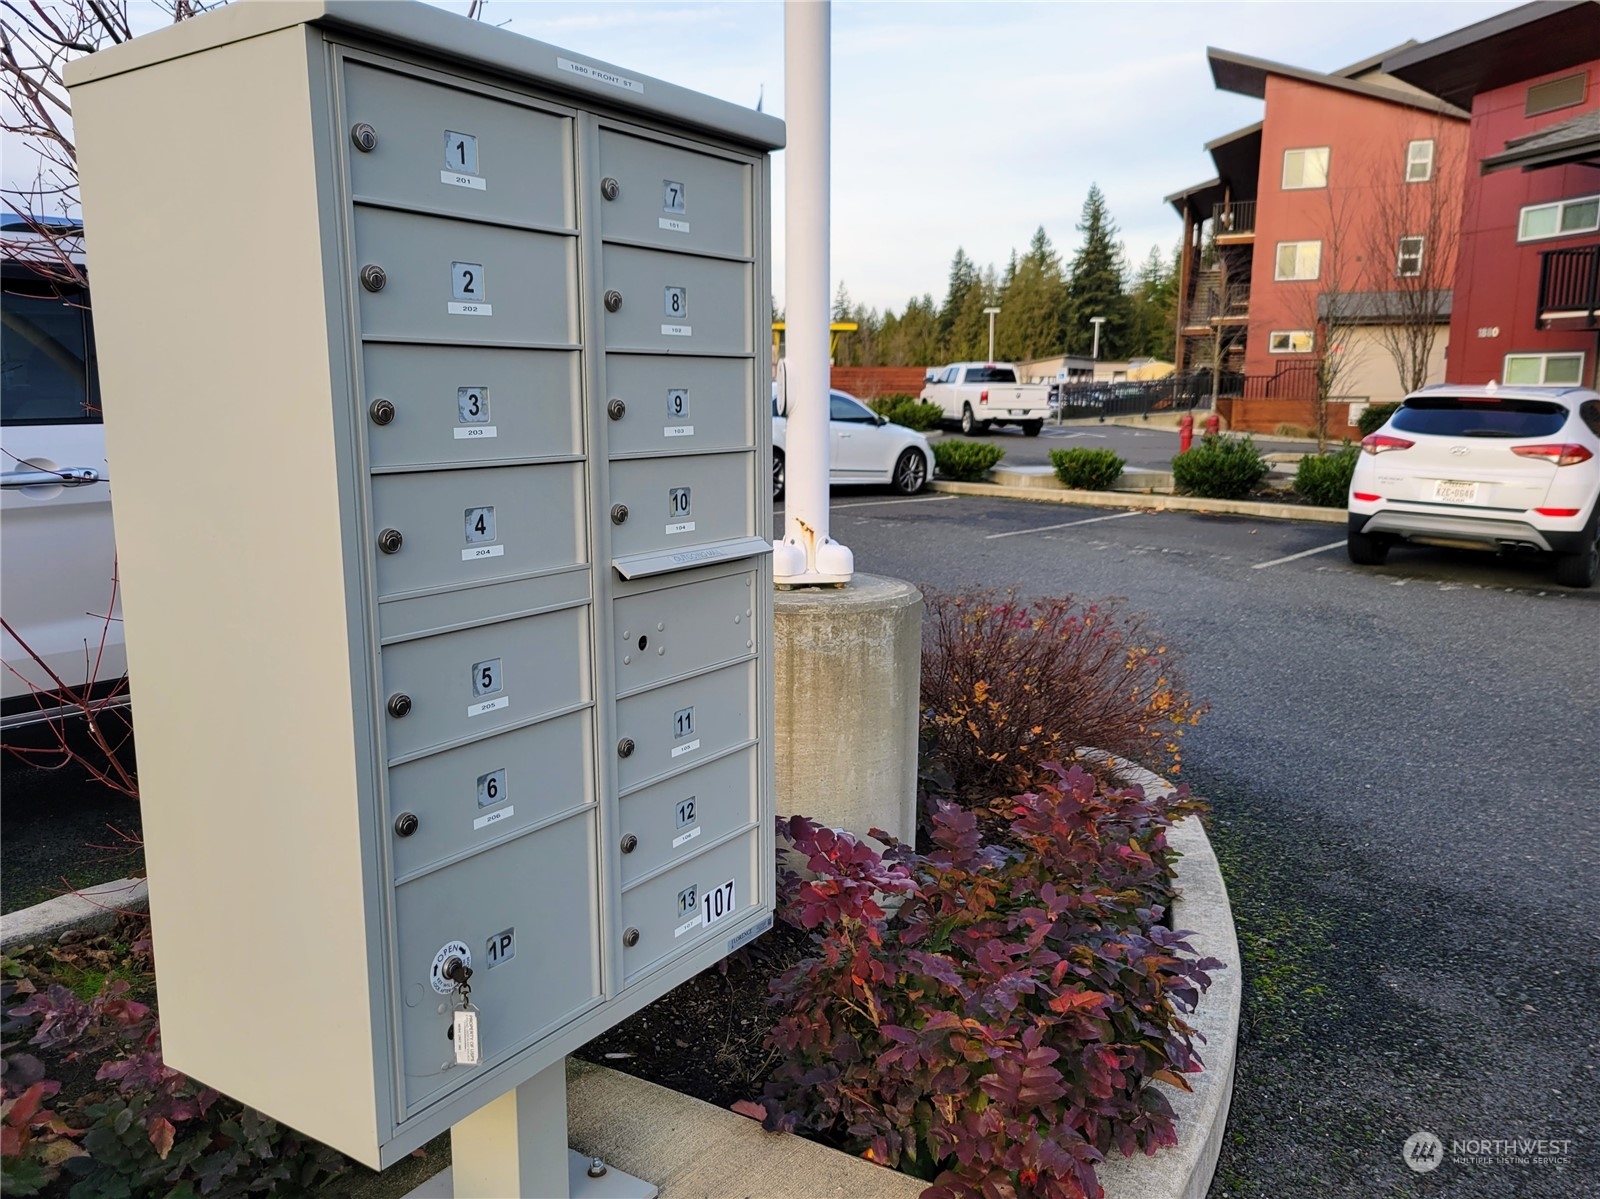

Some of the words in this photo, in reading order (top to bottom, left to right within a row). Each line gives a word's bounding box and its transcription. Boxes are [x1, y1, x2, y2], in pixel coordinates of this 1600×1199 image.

[570, 64, 588, 74] 1880
[592, 70, 619, 84] FRONT
[456, 141, 465, 164] 1
[456, 176, 472, 185] 201
[670, 188, 678, 207] 7
[462, 270, 474, 293] 2
[672, 294, 680, 312] 8
[468, 394, 480, 416] 3
[674, 395, 682, 414] 9
[672, 493, 688, 511] 10
[474, 514, 486, 535] 4
[482, 667, 492, 688] 5
[481, 702, 496, 711] 205
[677, 712, 692, 733] 11
[487, 778, 498, 799] 6
[486, 812, 502, 822] 206
[679, 802, 694, 823] 12
[680, 890, 696, 912] 13
[704, 882, 734, 924] 107
[438, 944, 459, 962] OPEN
[489, 934, 512, 961] 1P
